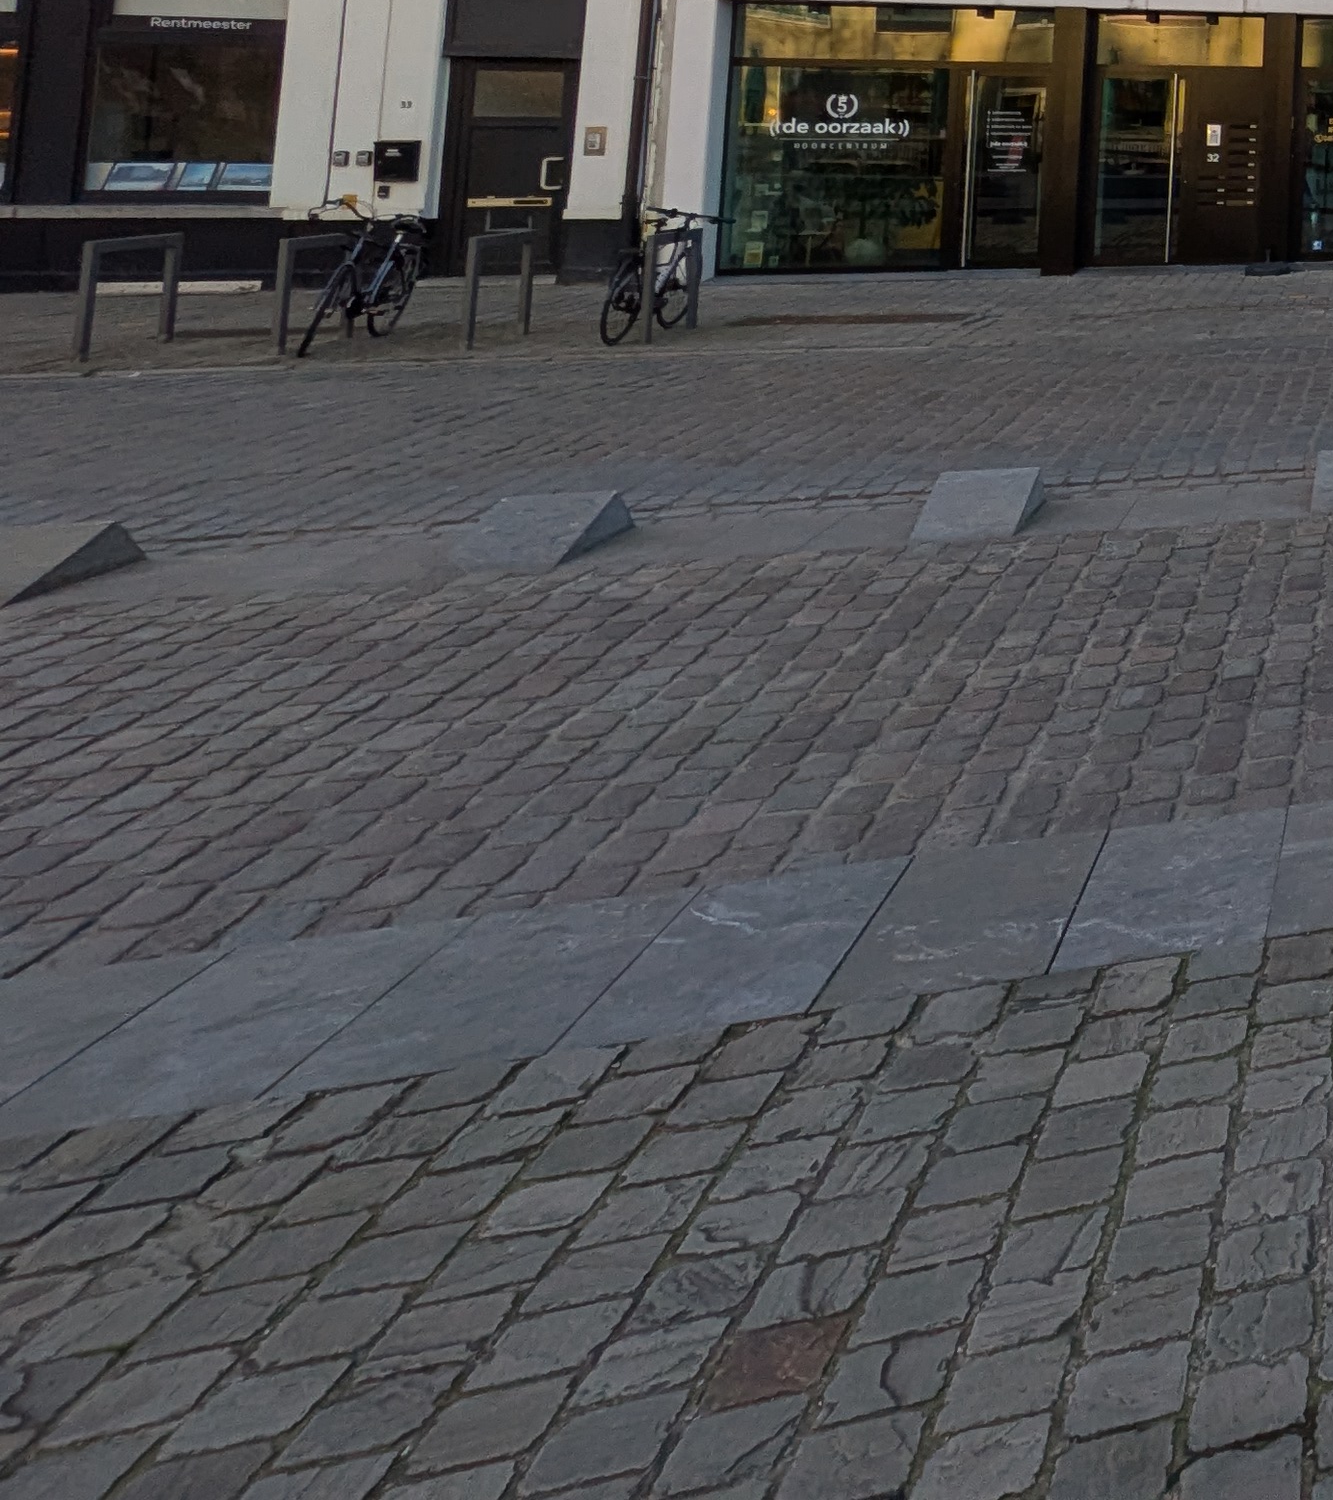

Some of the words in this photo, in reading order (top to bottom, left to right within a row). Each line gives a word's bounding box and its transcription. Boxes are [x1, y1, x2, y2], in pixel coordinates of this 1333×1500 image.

[150, 17, 252, 30] Rentmeester
[782, 117, 809, 134] de
[815, 117, 896, 134] oorzaak
[1206, 153, 1220, 163] 32
